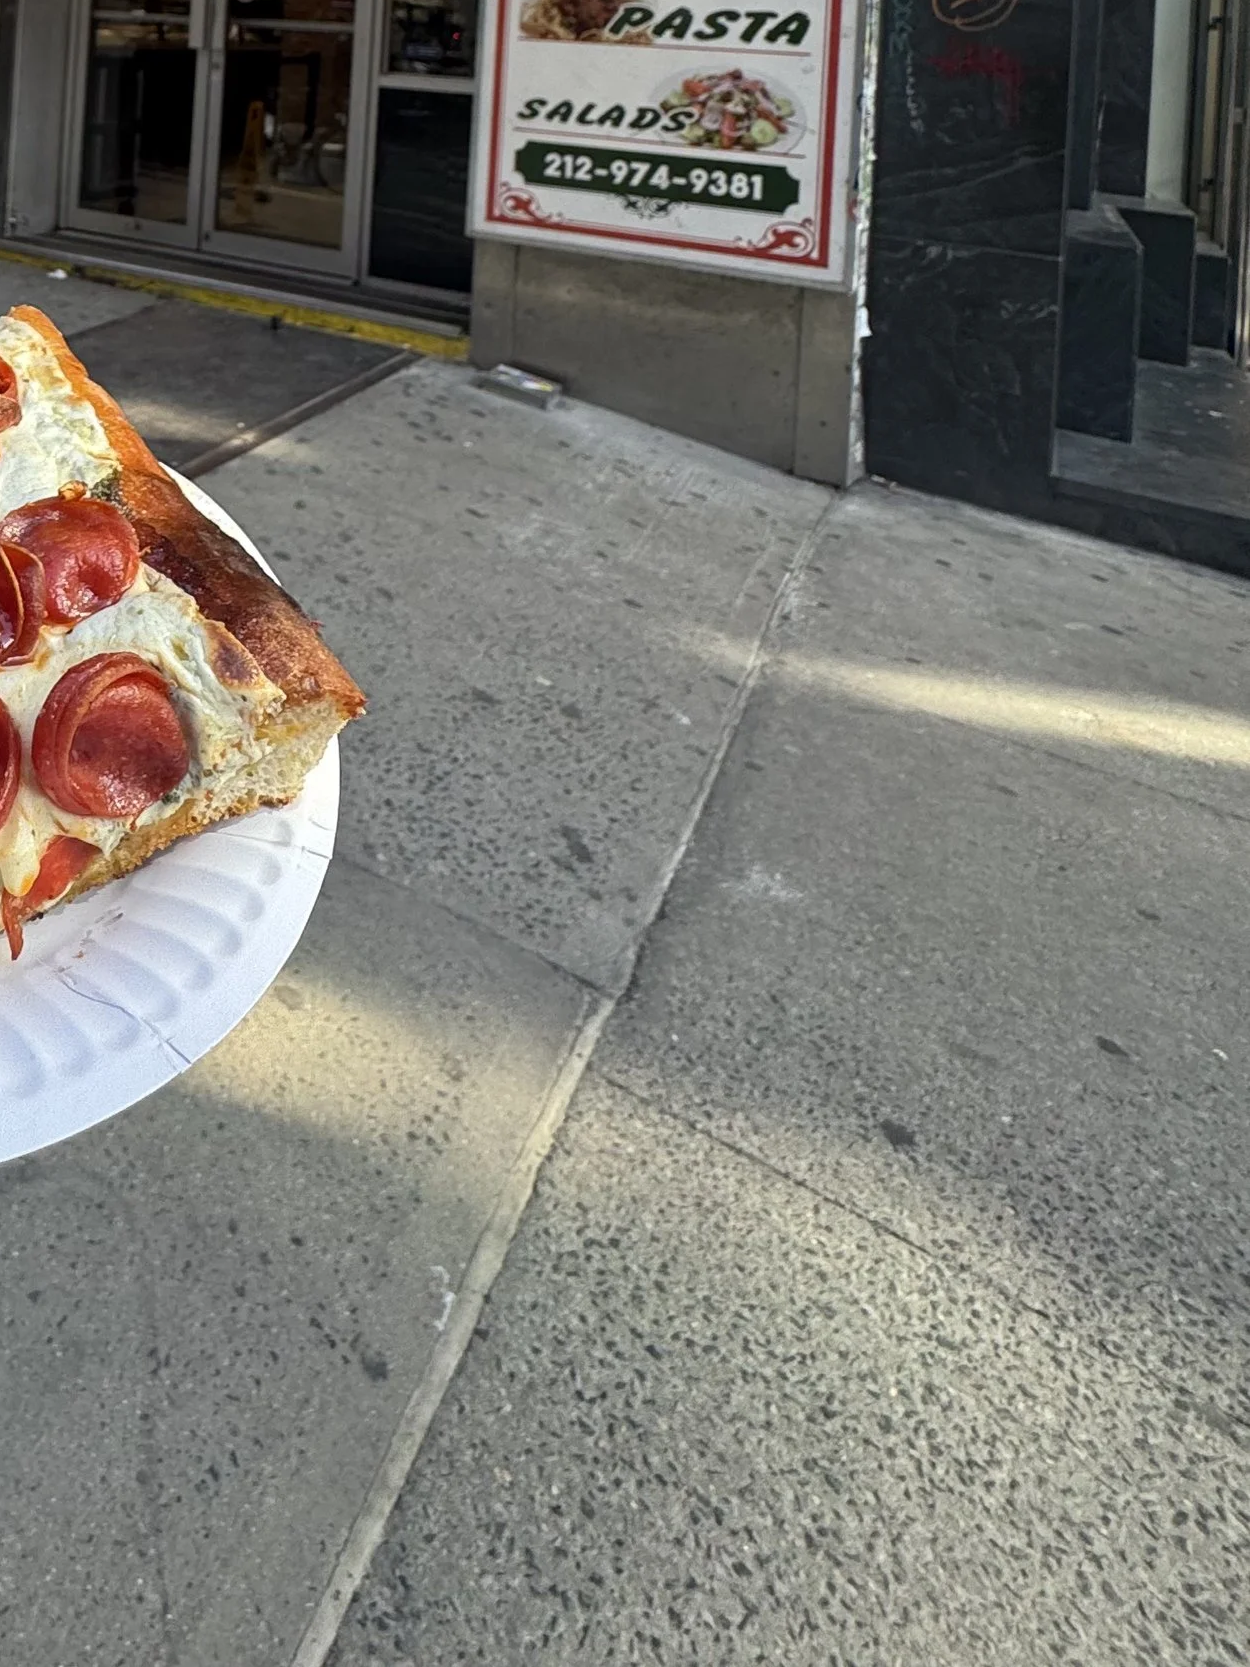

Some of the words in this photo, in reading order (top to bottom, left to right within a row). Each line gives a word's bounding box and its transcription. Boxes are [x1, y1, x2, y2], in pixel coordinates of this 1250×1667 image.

[608, 6, 814, 47] PASTA
[514, 95, 696, 134] SALADS
[543, 150, 764, 202] 212-974-9381
